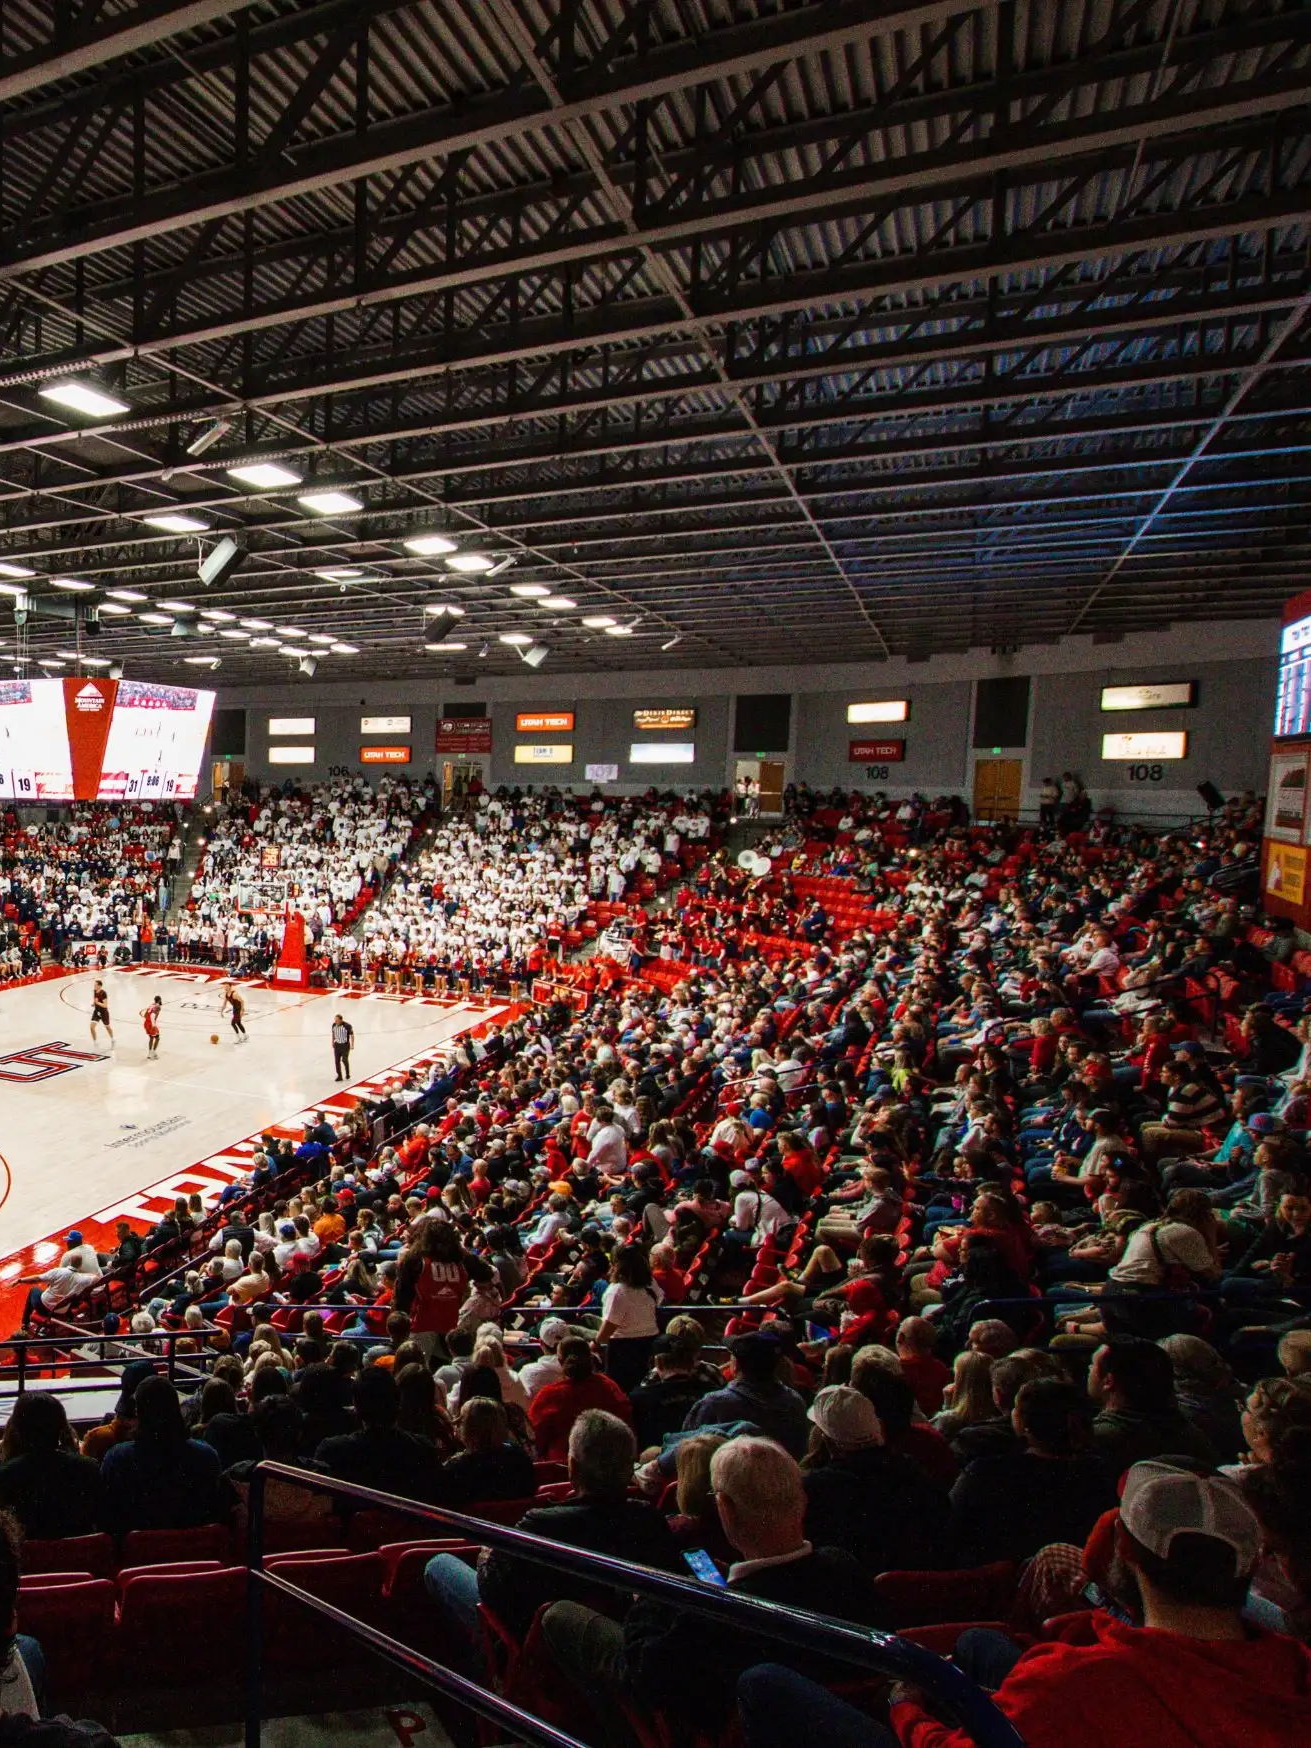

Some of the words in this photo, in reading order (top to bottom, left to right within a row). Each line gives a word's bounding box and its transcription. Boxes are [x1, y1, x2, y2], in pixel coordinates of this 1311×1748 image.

[520, 718, 544, 727] UTAH
[544, 717, 568, 726] TECH
[364, 751, 384, 759] UTAH
[385, 751, 405, 759] TECH
[853, 746, 874, 756] UTAH
[875, 745, 897, 756] TECH
[328, 765, 350, 777] 106
[865, 766, 889, 779] 108
[1127, 764, 1163, 781] 108
[18, 778, 31, 792] 19
[128, 779, 138, 792] 31
[165, 779, 175, 792] 19
[102, 1115, 186, 1149] Intermountain
[430, 1261, 460, 1283] 00
